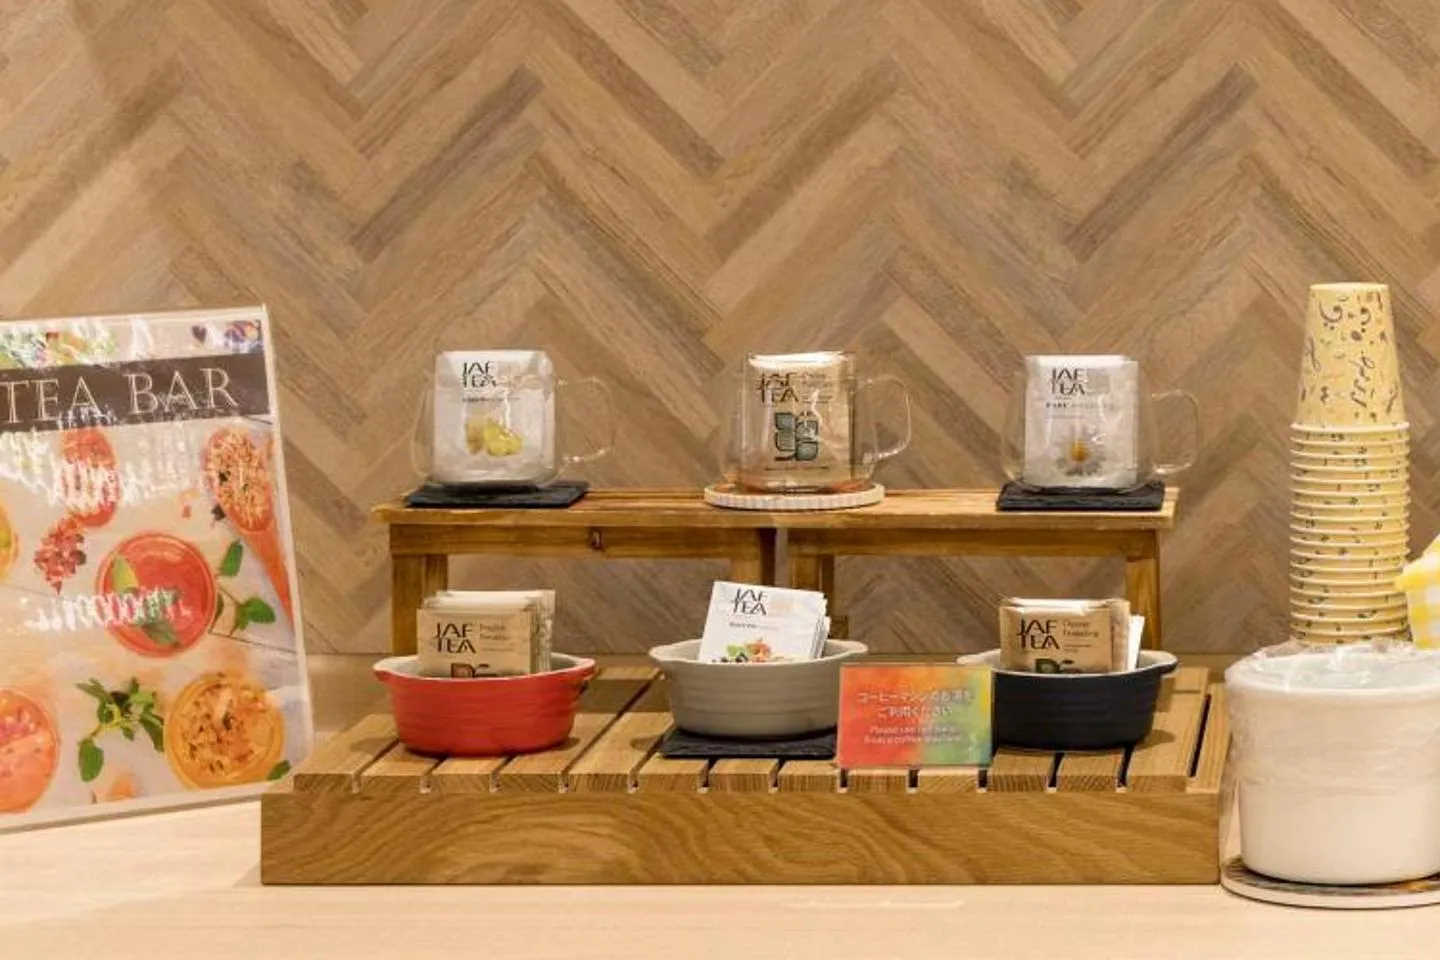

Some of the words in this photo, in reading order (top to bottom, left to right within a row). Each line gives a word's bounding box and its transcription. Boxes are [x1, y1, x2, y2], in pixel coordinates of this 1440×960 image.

[0, 375, 104, 424] TEA
[122, 367, 239, 414] BAR
[434, 622, 473, 638] JAF
[1016, 618, 1058, 635] JAF
